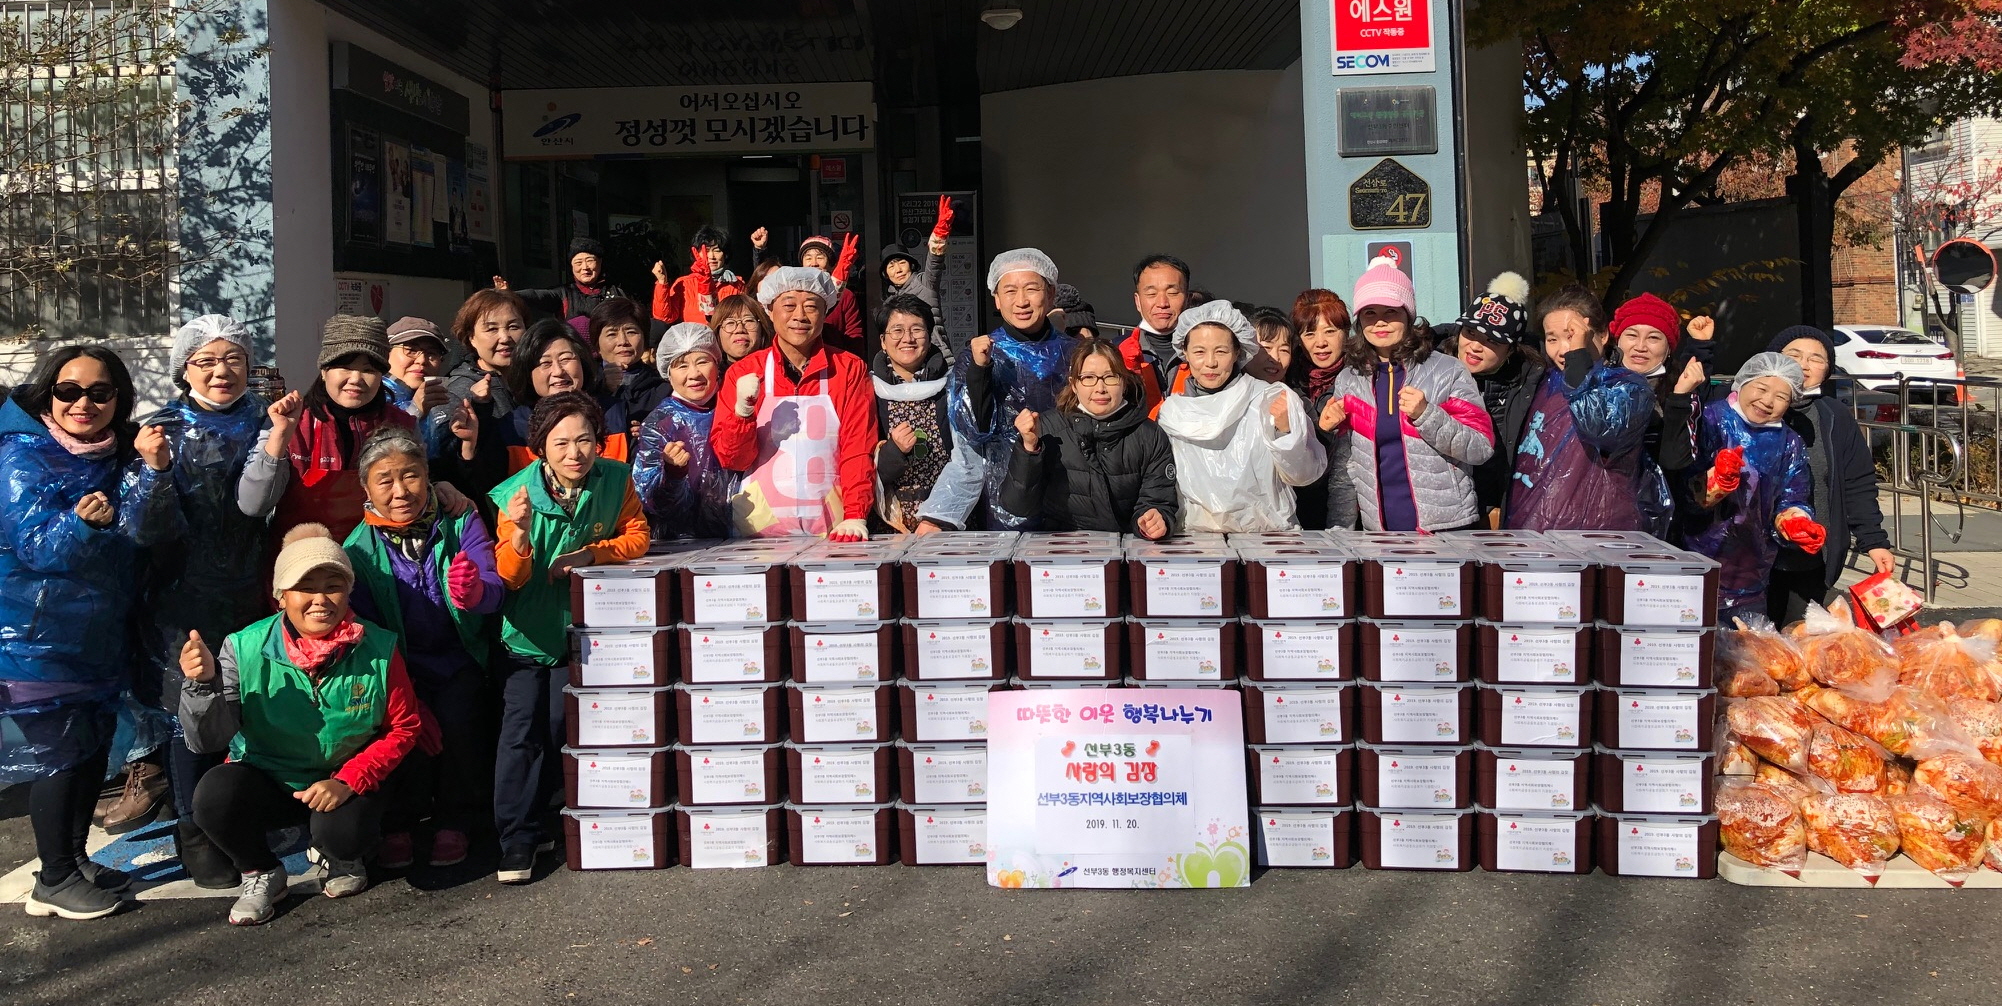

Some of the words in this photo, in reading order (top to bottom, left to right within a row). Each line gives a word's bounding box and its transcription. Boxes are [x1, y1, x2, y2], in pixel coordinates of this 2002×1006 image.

[1350, 0, 1412, 22] 에스원
[1360, 29, 1382, 37] CCTV
[1382, 28, 1405, 37] 작동중
[1337, 54, 1389, 69] SECOM
[679, 91, 802, 112] 어서오십시오
[615, 118, 697, 146] 정성껏
[705, 114, 869, 144] 모시겠습니다
[541, 137, 574, 146] 안산시
[1386, 193, 1426, 222] 47
[1476, 301, 1509, 326] PS
[1016, 704, 1071, 724] 따뜻한
[1080, 704, 1114, 724] 이웃
[1122, 703, 1213, 724] 행복나누기
[1084, 742, 1136, 757] 선부3동
[1065, 762, 1115, 782] 사랑의
[1126, 762, 1158, 782] 김장
[1037, 792, 1188, 806] 선부3동지역사회보장협의체
[1086, 819, 1108, 829] 2019.
[1112, 819, 1122, 829] 11.
[1126, 819, 1140, 829] 20.
[1083, 868, 1109, 876] 선부3동
[1112, 867, 1156, 876] 행정복지센터
